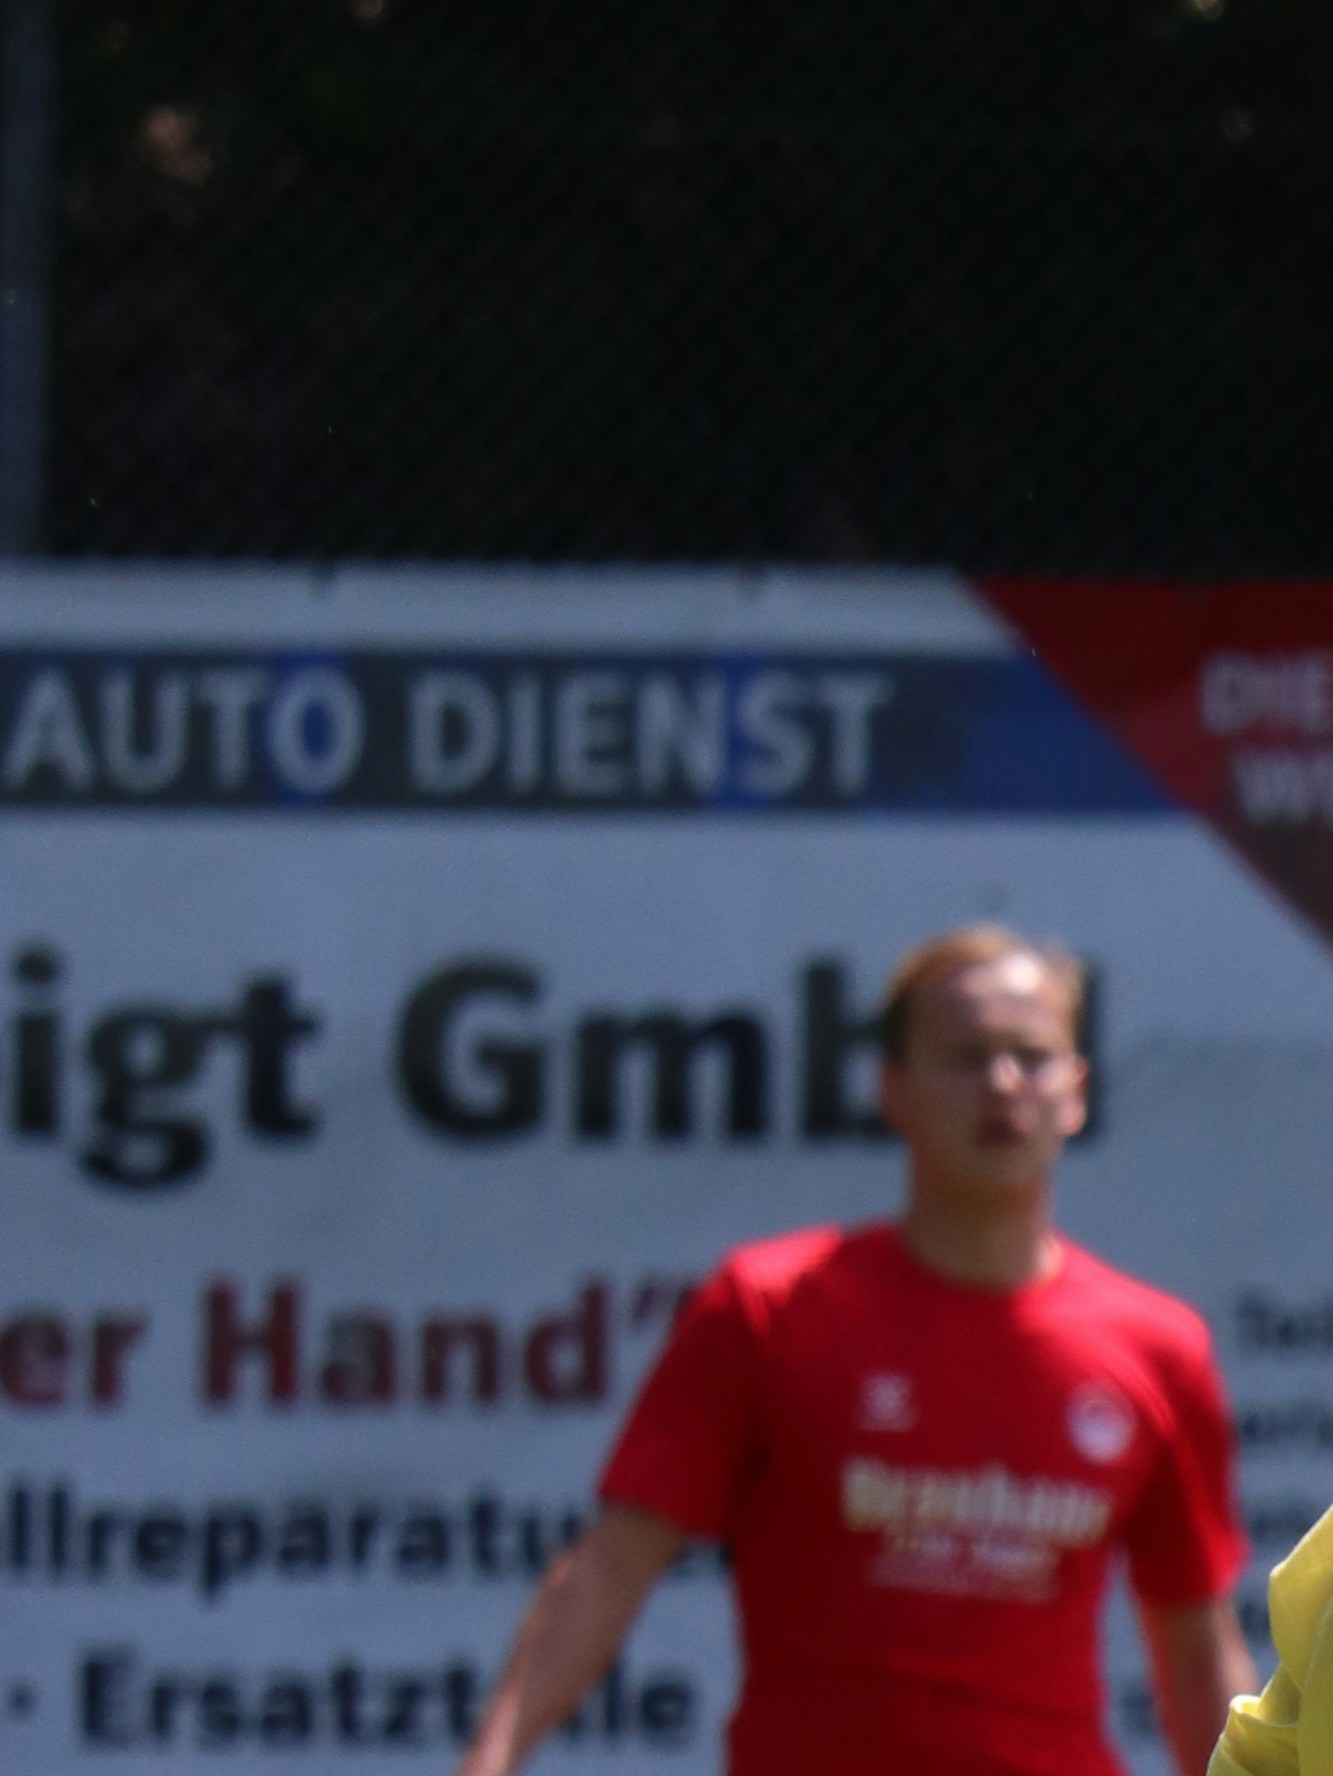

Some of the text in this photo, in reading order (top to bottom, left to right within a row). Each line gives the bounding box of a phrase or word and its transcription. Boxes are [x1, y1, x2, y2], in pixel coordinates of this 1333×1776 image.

[5, 666, 893, 798] AUTO DIENST
[12, 942, 1106, 1198] igt Gmb
[0, 1308, 146, 1414] er
